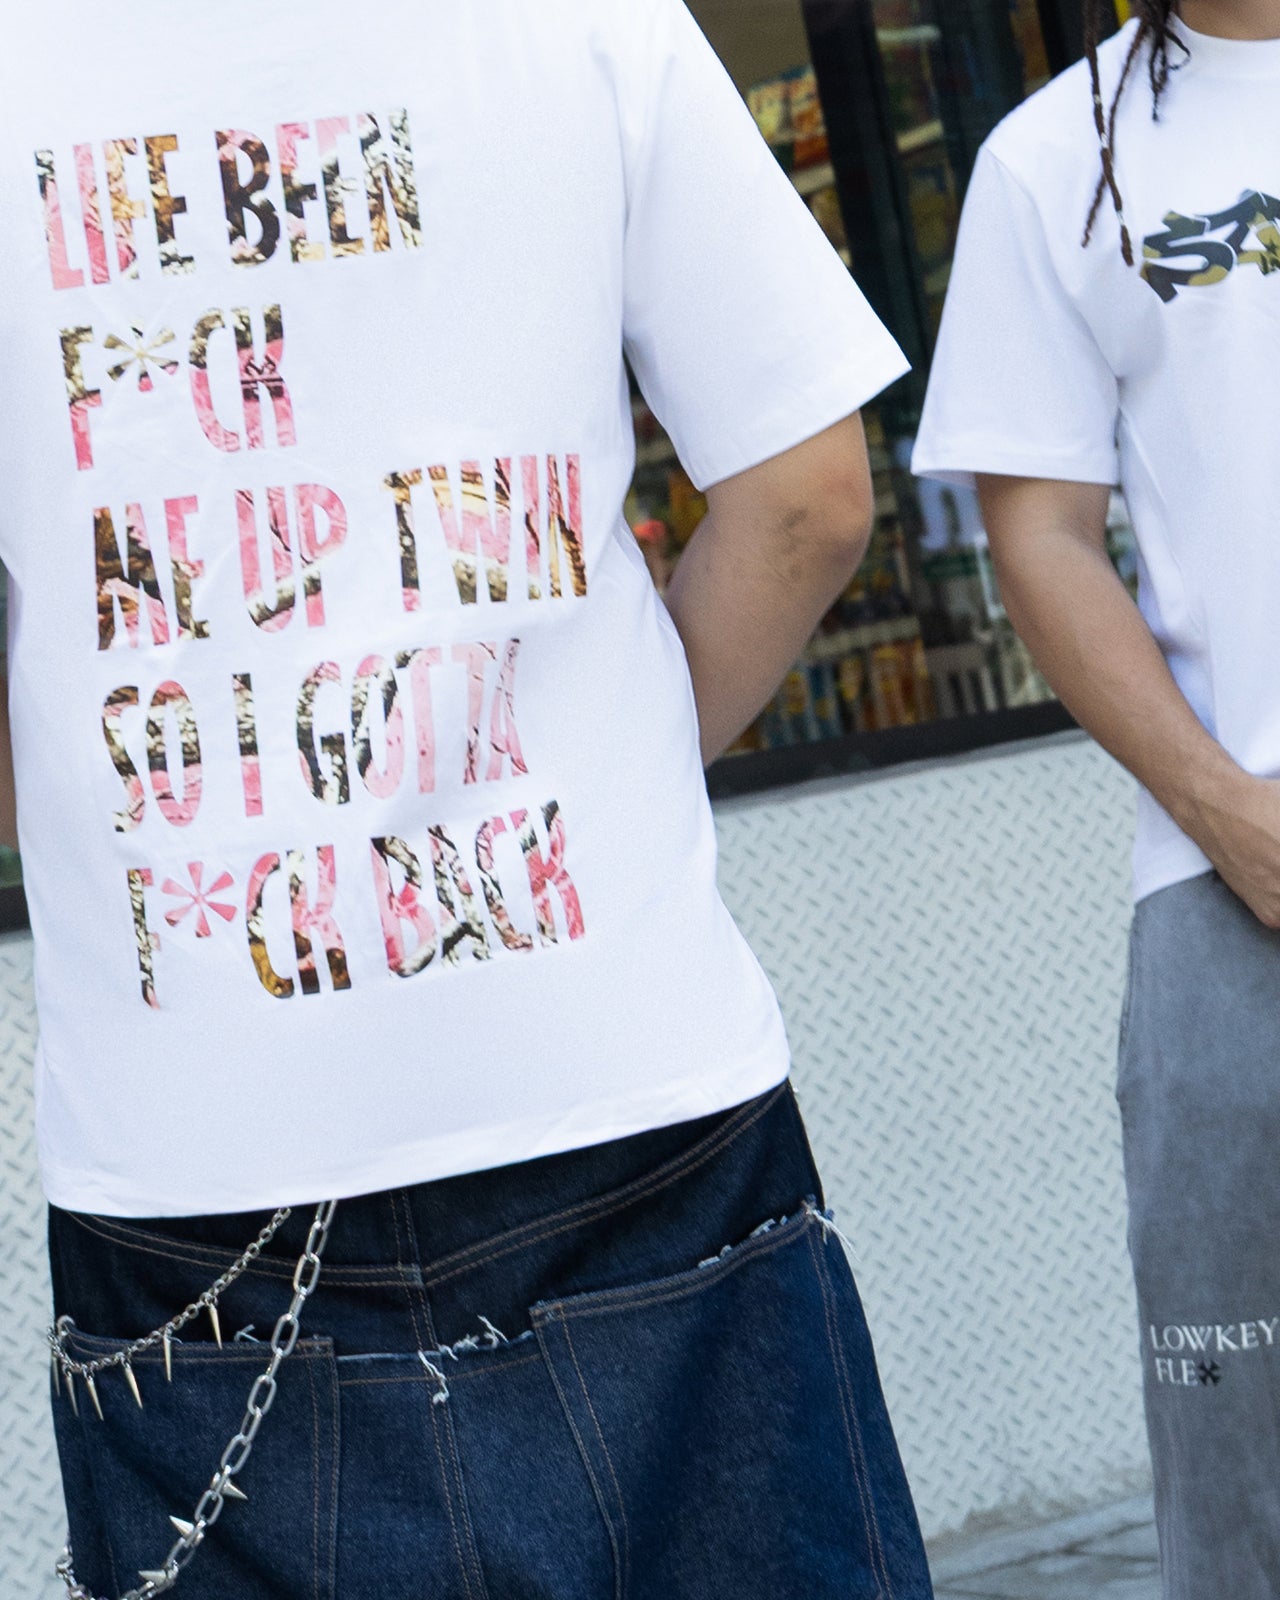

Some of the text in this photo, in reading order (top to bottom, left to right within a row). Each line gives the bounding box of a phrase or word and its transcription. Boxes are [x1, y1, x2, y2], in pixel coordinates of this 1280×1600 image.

[33, 106, 425, 291] LIFE BEEN
[92, 451, 589, 653] ME UP TWIN
[100, 636, 531, 834] SO I GOTTA
[369, 798, 587, 979] BACK
[1149, 1316, 1280, 1352] LOWKEY
